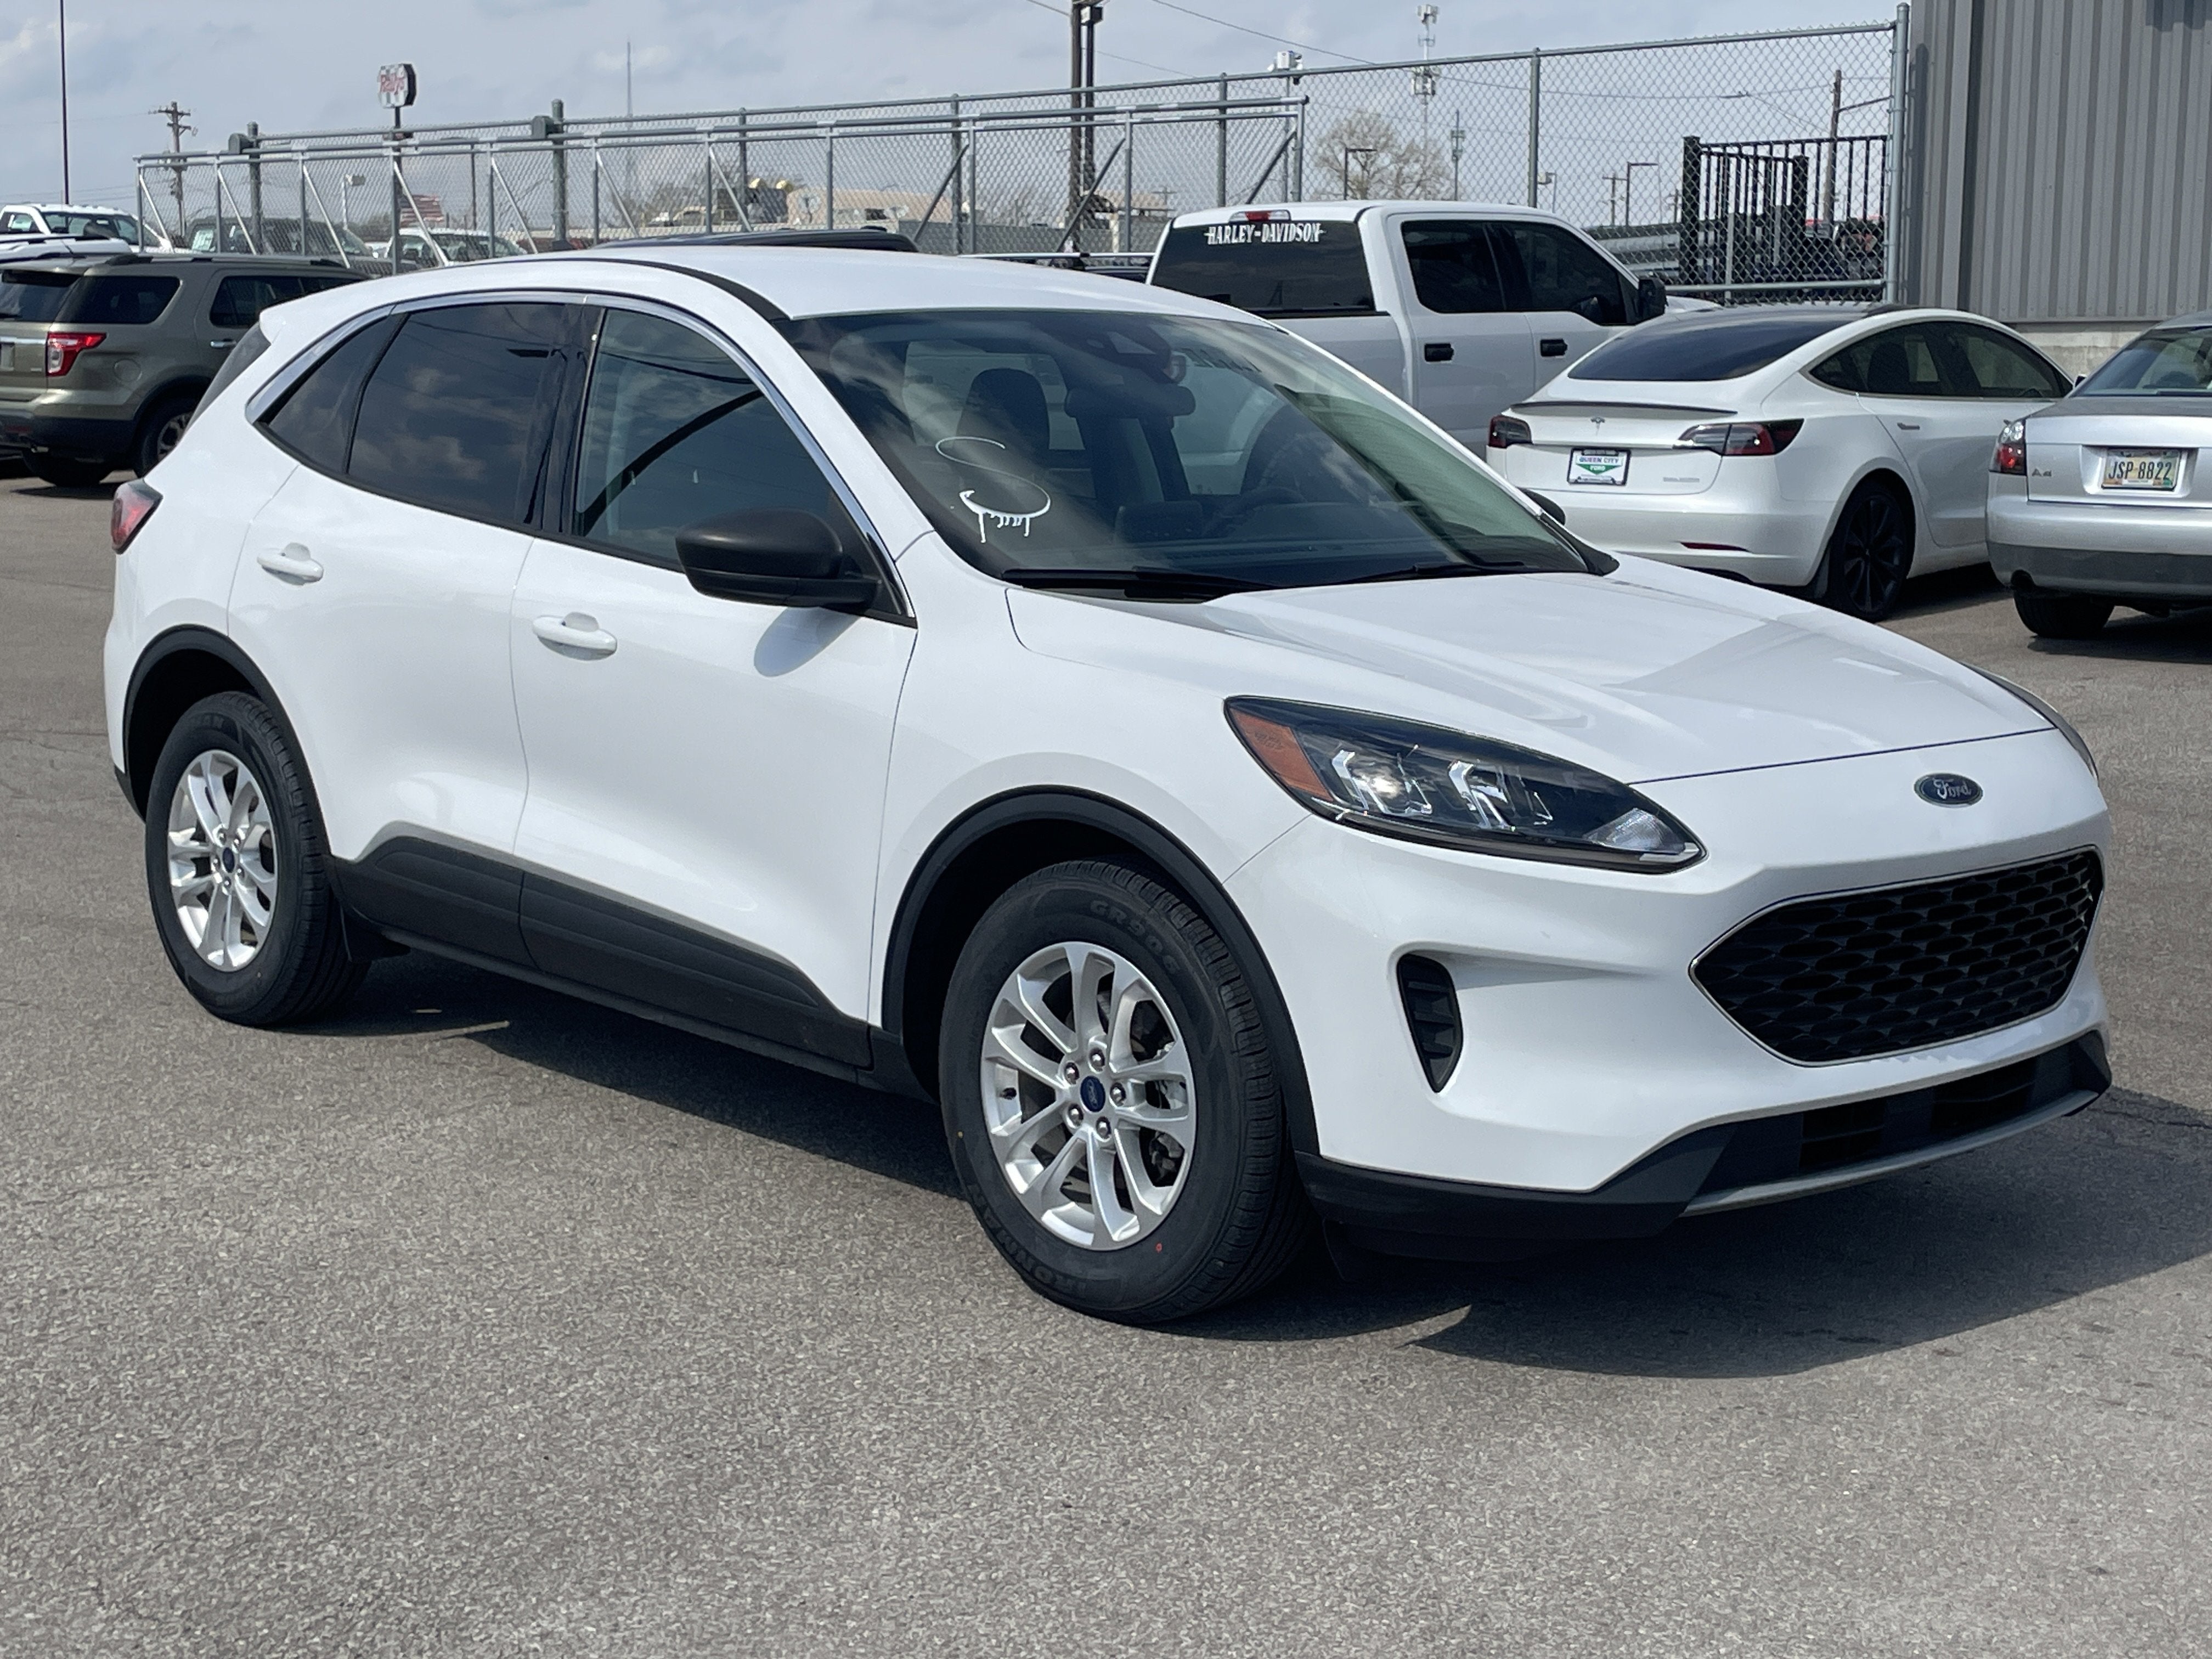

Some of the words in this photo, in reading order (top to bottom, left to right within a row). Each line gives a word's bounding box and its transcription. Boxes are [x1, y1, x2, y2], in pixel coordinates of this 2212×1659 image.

[1205, 223, 1326, 245] HARLEY-DAVIDSON
[2108, 461, 2134, 479] JSP
[2138, 461, 2172, 480] 8822
[1932, 778, 1971, 799] Ford
